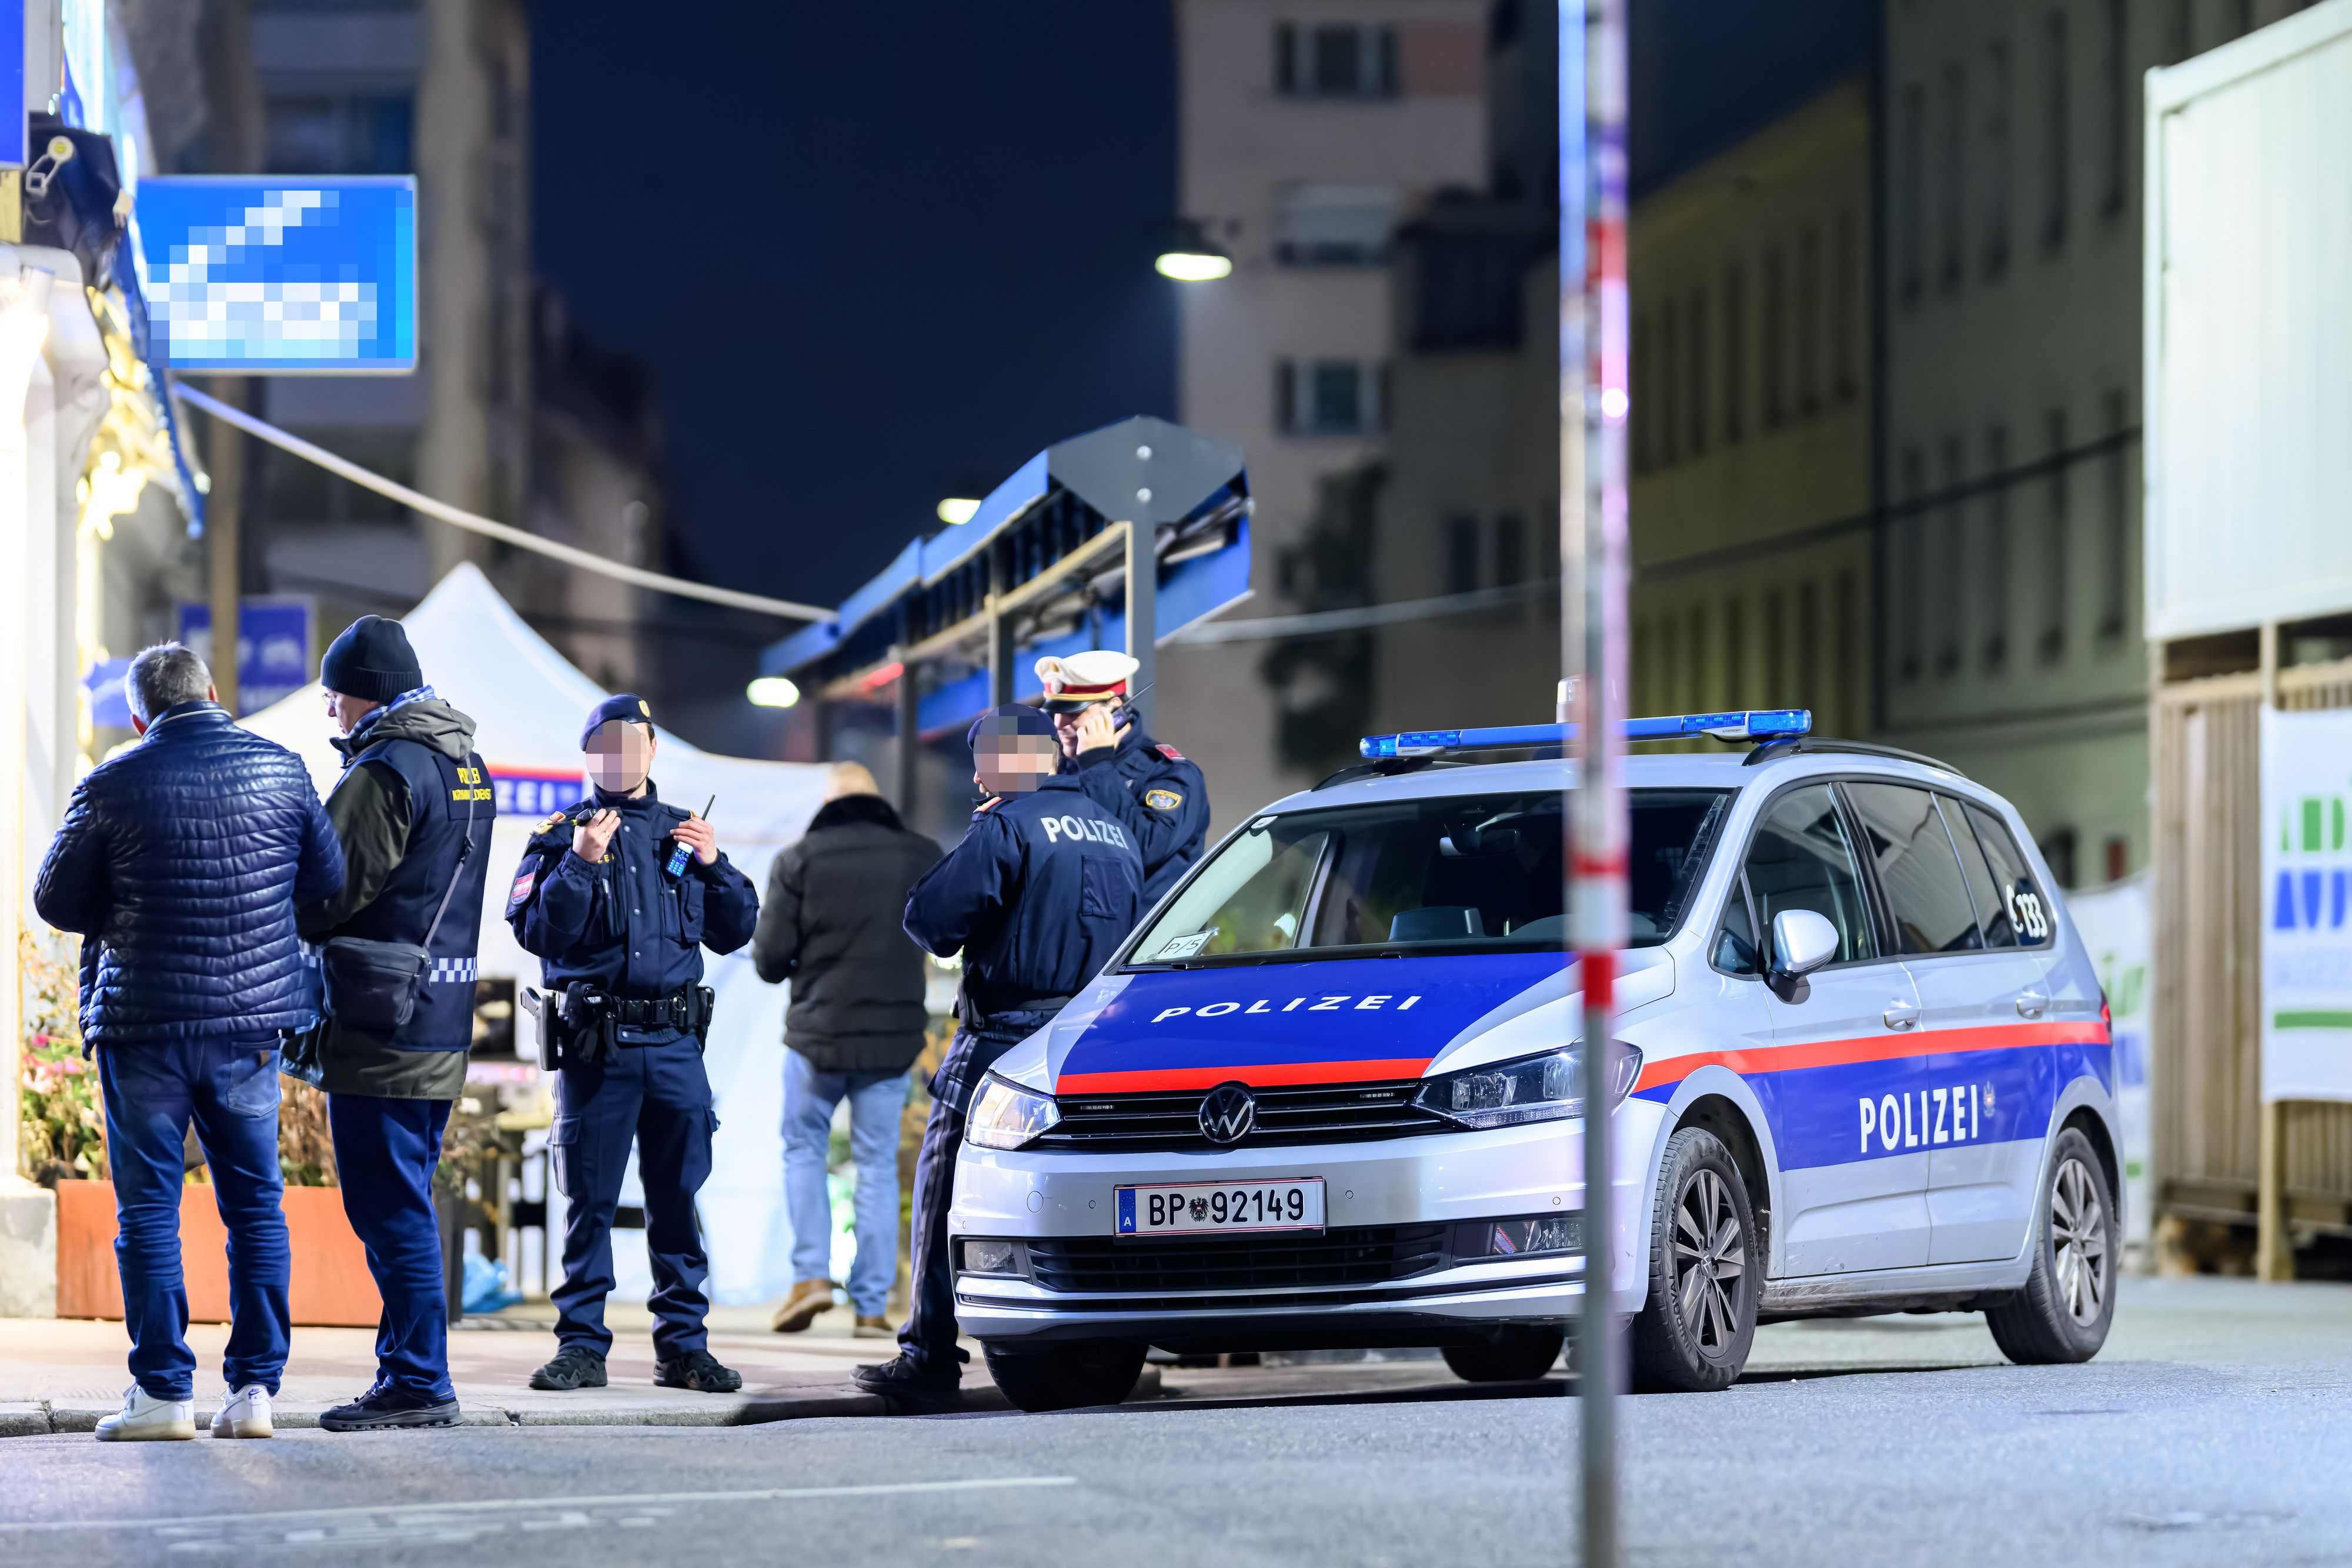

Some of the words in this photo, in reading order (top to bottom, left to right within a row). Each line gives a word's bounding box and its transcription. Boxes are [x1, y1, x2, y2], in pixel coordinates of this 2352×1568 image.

[1040, 815, 1130, 850] POLIZEI
[2015, 892, 2048, 938] 133
[1164, 938, 1202, 954] P/5
[1150, 995, 1422, 1023] POLIZEI
[1859, 1084, 1979, 1154] POLIZEI
[1123, 1216, 1132, 1227] A
[1149, 1193, 1186, 1226] BP
[1210, 1188, 1305, 1224] 92149
